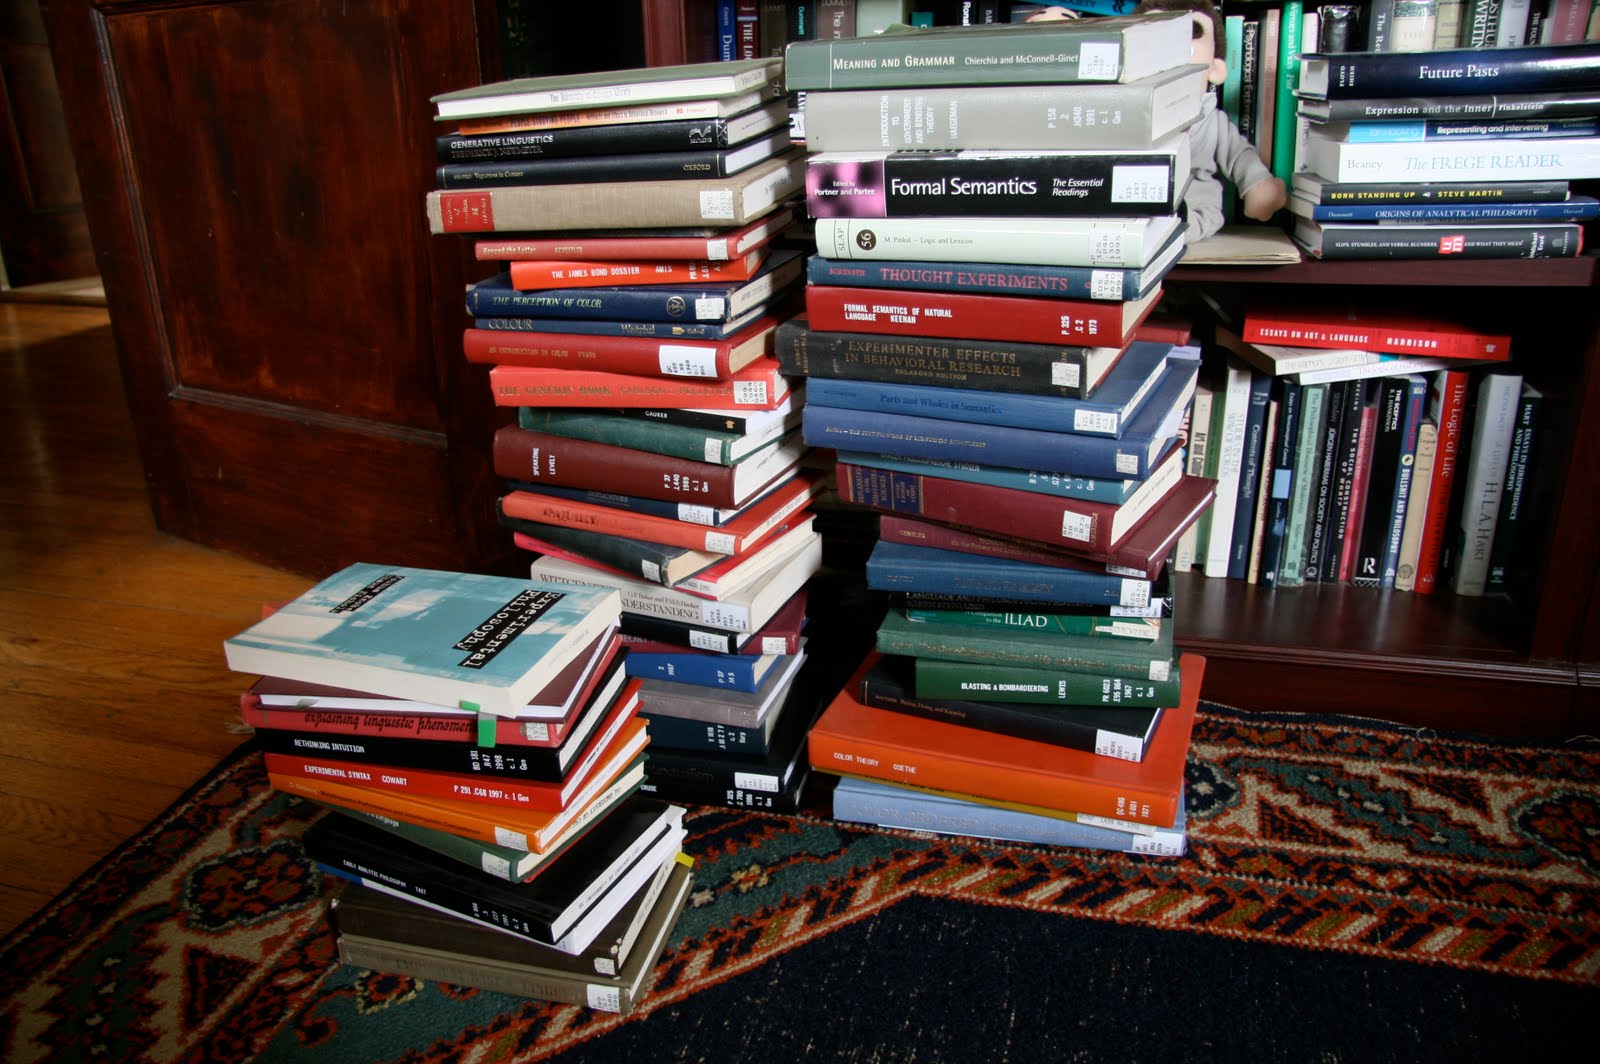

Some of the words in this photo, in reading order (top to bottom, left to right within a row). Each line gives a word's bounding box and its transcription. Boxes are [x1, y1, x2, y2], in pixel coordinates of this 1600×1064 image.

[834, 58, 876, 70] MEANING
[881, 59, 900, 68] AND
[905, 56, 955, 67] GRAMMAR
[965, 56, 997, 65] Chierchia
[1000, 55, 1013, 64] and
[1016, 54, 1078, 63] McConnell-Ginet
[1419, 66, 1462, 79] Future
[1467, 64, 1498, 78] Pasts
[950, 101, 958, 139] HAEGEMAN
[1366, 107, 1418, 116] Expression
[892, 116, 899, 126] TO
[1437, 126, 1487, 135] Representing
[451, 138, 500, 149] GENERATIVE
[502, 134, 554, 145] LINGUISTICS
[1348, 160, 1383, 171] Beaney
[1406, 157, 1428, 170] The
[1432, 156, 1485, 169] FREGE
[1491, 154, 1563, 169] READER
[891, 178, 946, 196] Formal
[950, 177, 1037, 195] Semantics
[1068, 178, 1104, 187] Essential
[1052, 188, 1089, 198] Readings
[1426, 209, 1481, 217] ANALYTICAL
[861, 233, 871, 247] 56
[611, 267, 640, 275] DOSSIER
[829, 268, 865, 276] SORENSEN
[880, 268, 953, 283] THOUGHT
[957, 270, 1068, 290] EXPERIMENTS
[493, 297, 509, 305] THE
[512, 297, 560, 307] PERCEPTION
[564, 298, 574, 306] OF
[577, 299, 602, 308] COLOR
[844, 304, 868, 312] FORMAL
[872, 306, 908, 315] SEMANTICS
[924, 309, 952, 317] NATURAL
[488, 319, 533, 330] COLOUR
[845, 312, 876, 321] LANGUAGE
[890, 315, 916, 324] KEENAN
[1061, 316, 1069, 327] 325
[1089, 320, 1097, 335] 1973
[1260, 328, 1288, 338] ESSAYS
[1330, 333, 1368, 344] LANGUAGE
[1386, 337, 1438, 349] HARRISON
[849, 341, 949, 358] EXPERIMENTER
[957, 349, 1016, 364] EFFECTS
[845, 353, 859, 363] IN
[864, 355, 945, 371] BEHAVIORAL
[949, 361, 1022, 377] RESEARCH
[1453, 385, 1464, 404] The
[880, 394, 900, 403] Parts
[902, 398, 918, 406] and
[920, 398, 949, 409] Wholes
[951, 401, 959, 409] in
[961, 402, 1003, 414] Semantics
[645, 410, 668, 418] GAUKER
[1391, 402, 1400, 430] SCEPTICS
[1446, 408, 1461, 438] Logic
[1523, 404, 1532, 424] HART
[1249, 425, 1260, 457] Contents
[1347, 448, 1356, 476] SOCIAL
[1442, 457, 1454, 477] Life
[1507, 448, 1519, 491] PHILOSOPHY
[1399, 468, 1410, 499] BULLSHIT
[1509, 464, 1525, 520] JURISPRUDENCE
[1338, 480, 1351, 539] CONSTRUCTION
[1389, 515, 1401, 554] PHILOSOPHY
[681, 599, 699, 609] Hacker
[457, 590, 541, 651] Philosophy
[1004, 613, 1048, 628] ILIAD
[463, 592, 562, 668] Experimental
[961, 682, 991, 691] BLASTING
[999, 684, 1048, 693] BOMBARDIERING
[304, 711, 359, 728] explaining
[363, 714, 414, 732] linguistic
[294, 739, 330, 750] RETHINKING
[332, 742, 365, 753] INTUITION
[495, 755, 504, 770] 1998
[520, 759, 528, 770] Gen
[834, 752, 853, 761] COLOR
[856, 756, 879, 766] THEORY
[893, 764, 917, 774] GOETHE
[304, 765, 346, 778] EXPERIMENTAL
[348, 771, 371, 780] SYNTAX
[382, 775, 407, 786] COWART
[473, 788, 487, 797] .C68
[488, 790, 502, 799] 1997
[343, 859, 356, 869] EARLY
[358, 864, 379, 878] ANALYTIC
[379, 873, 407, 887] PHILOSOPHY
